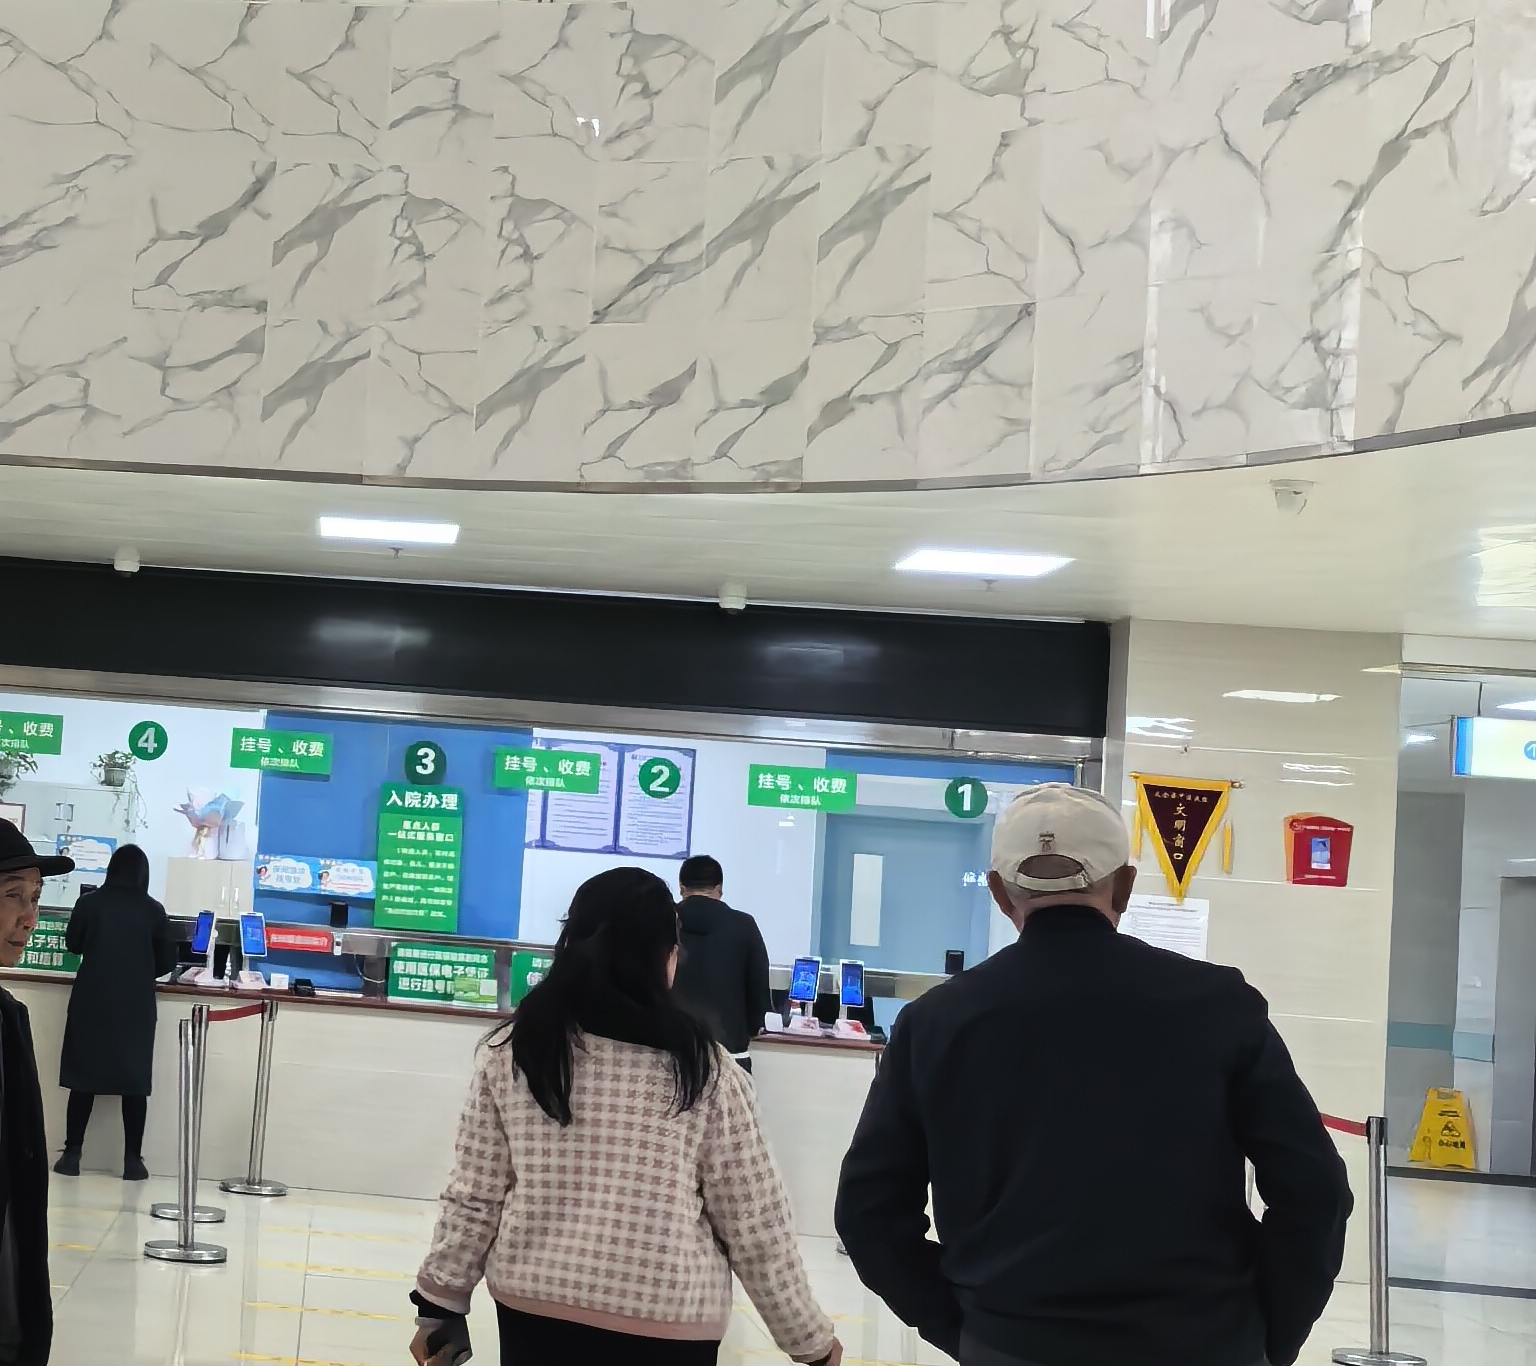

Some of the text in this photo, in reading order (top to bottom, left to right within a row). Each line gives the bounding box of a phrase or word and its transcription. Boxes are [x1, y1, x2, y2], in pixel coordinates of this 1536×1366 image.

[137, 727, 158, 754] 4
[240, 736, 324, 757] 挂号、收费
[415, 747, 436, 774] 3
[504, 754, 591, 777] 挂号、收费
[649, 765, 670, 793] 2
[758, 772, 848, 795] 挂号、收费
[386, 790, 458, 810] 入院办理
[957, 783, 973, 811] 1
